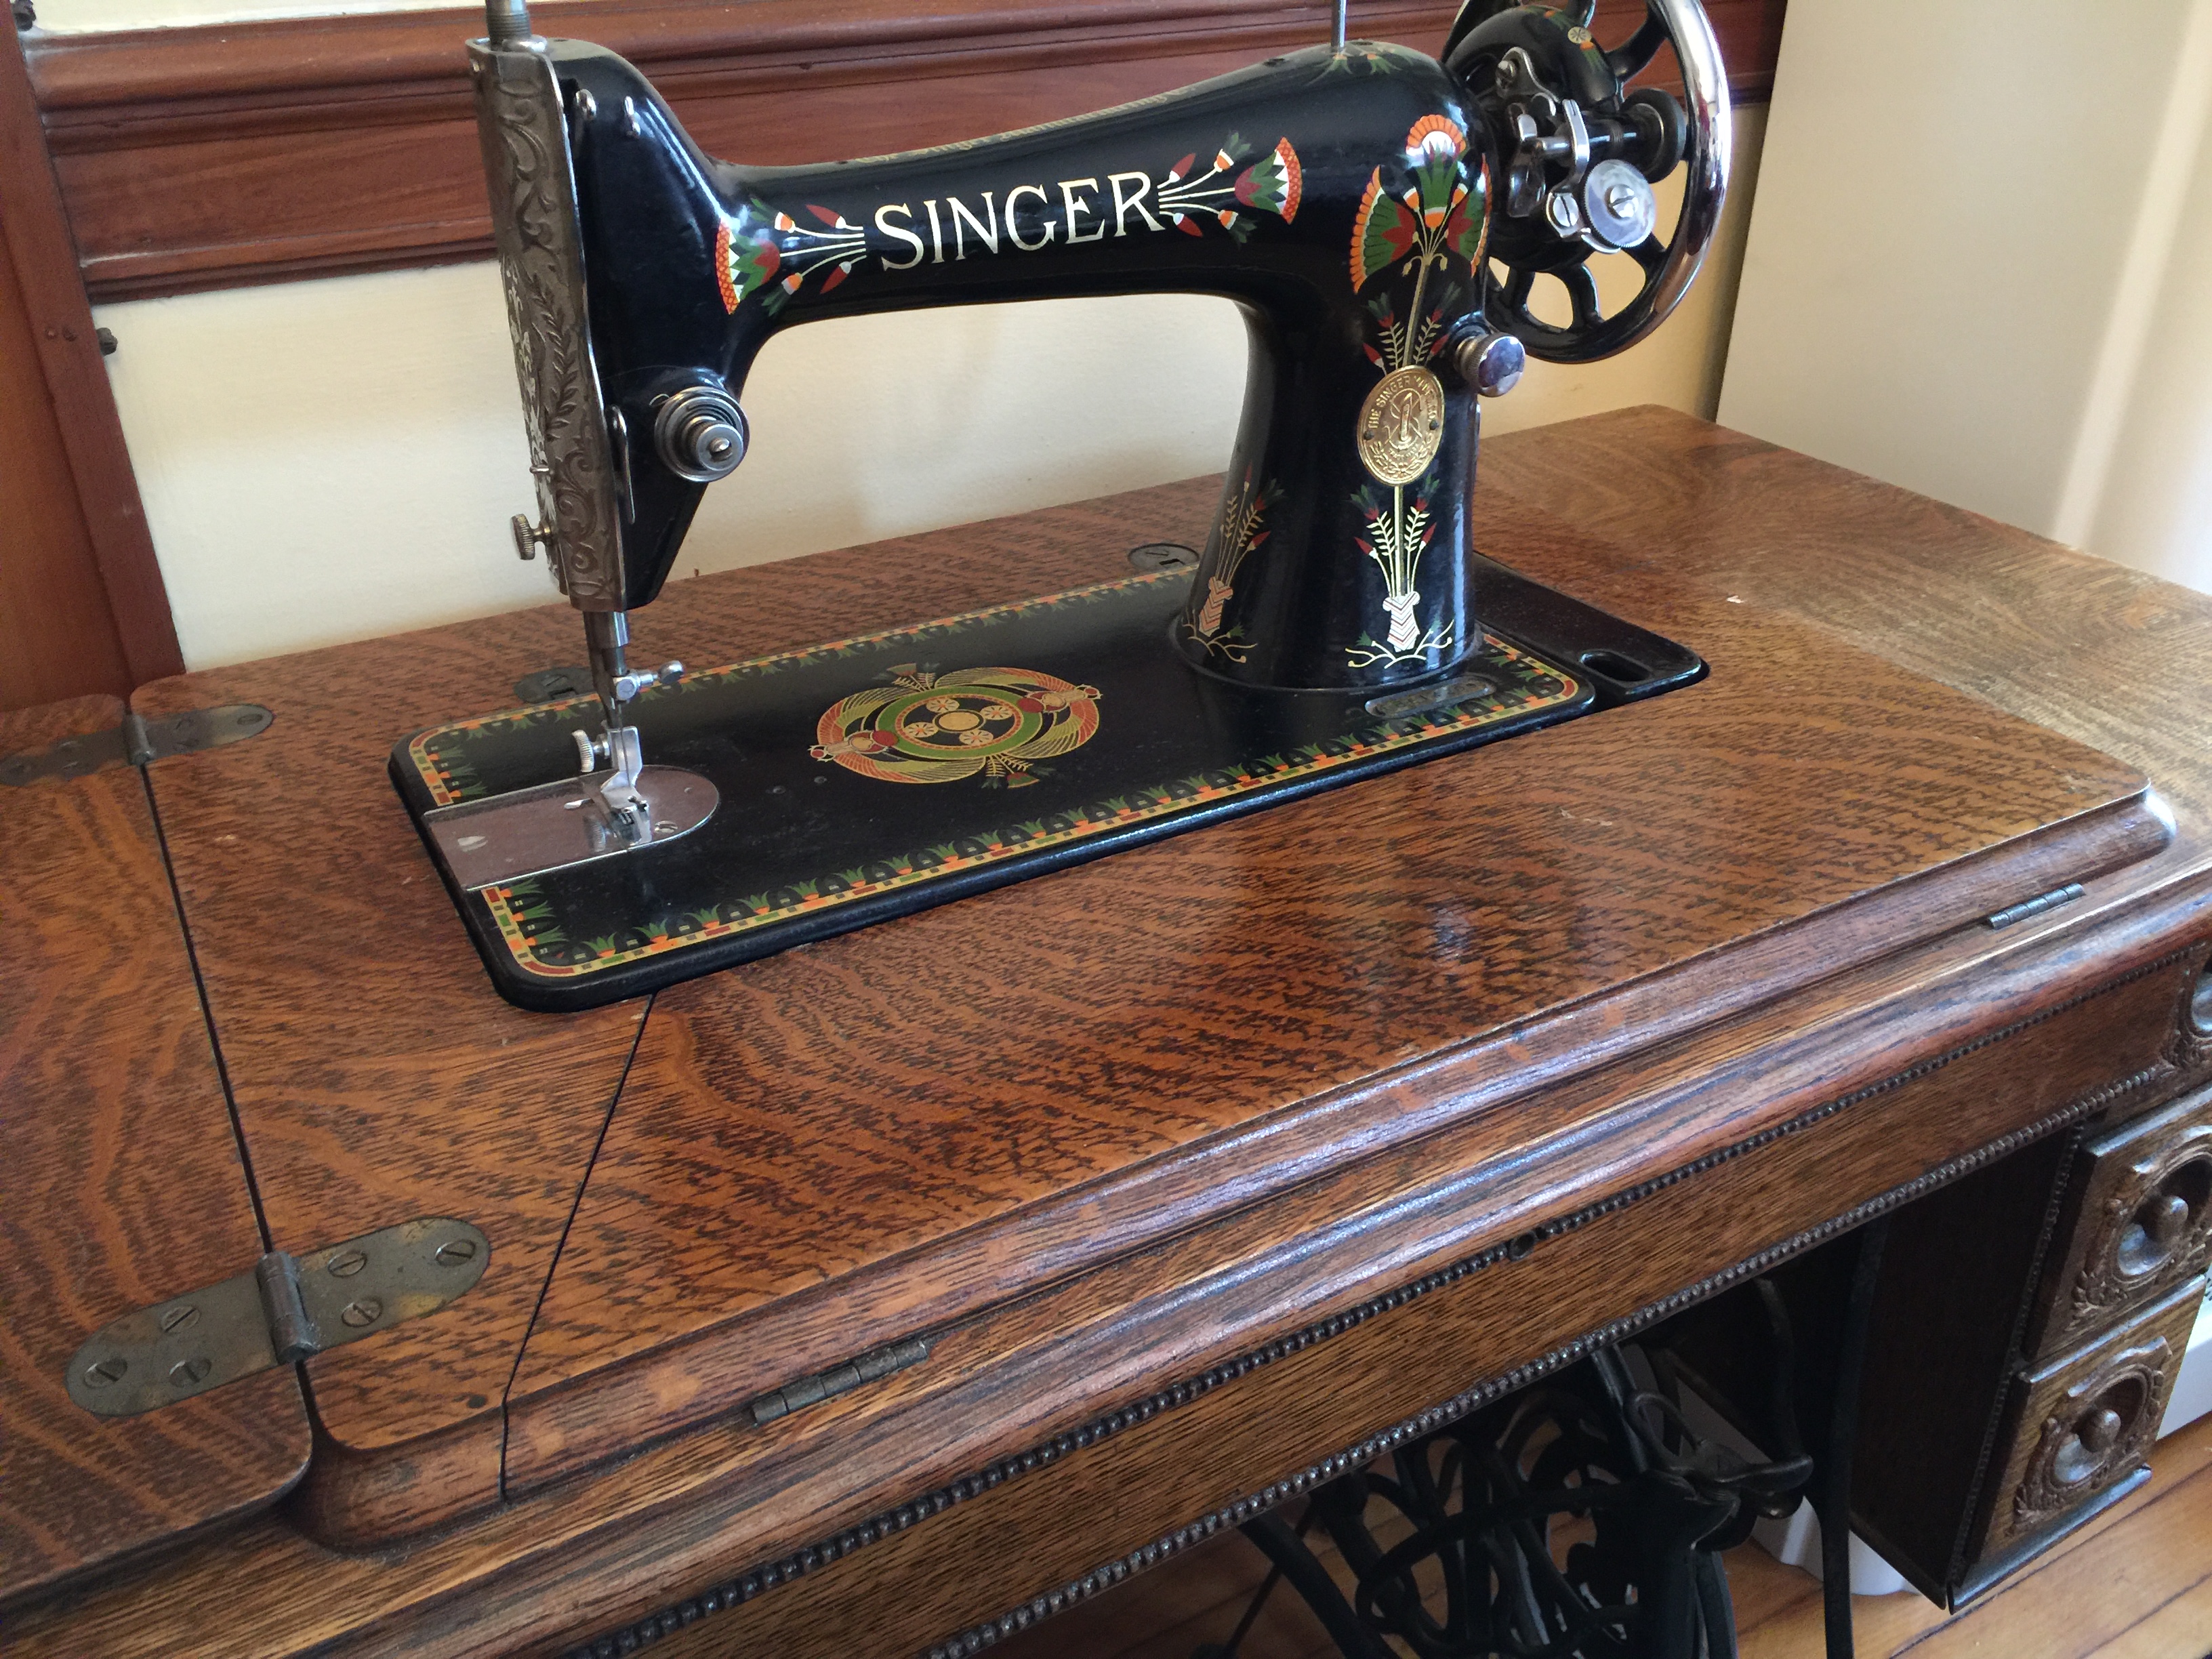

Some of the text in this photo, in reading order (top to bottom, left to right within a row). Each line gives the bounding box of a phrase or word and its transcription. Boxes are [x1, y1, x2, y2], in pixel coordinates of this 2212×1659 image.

[874, 171, 1166, 272] SINGER
[1368, 409, 1382, 428] THE
[1376, 375, 1411, 408] SINGER
